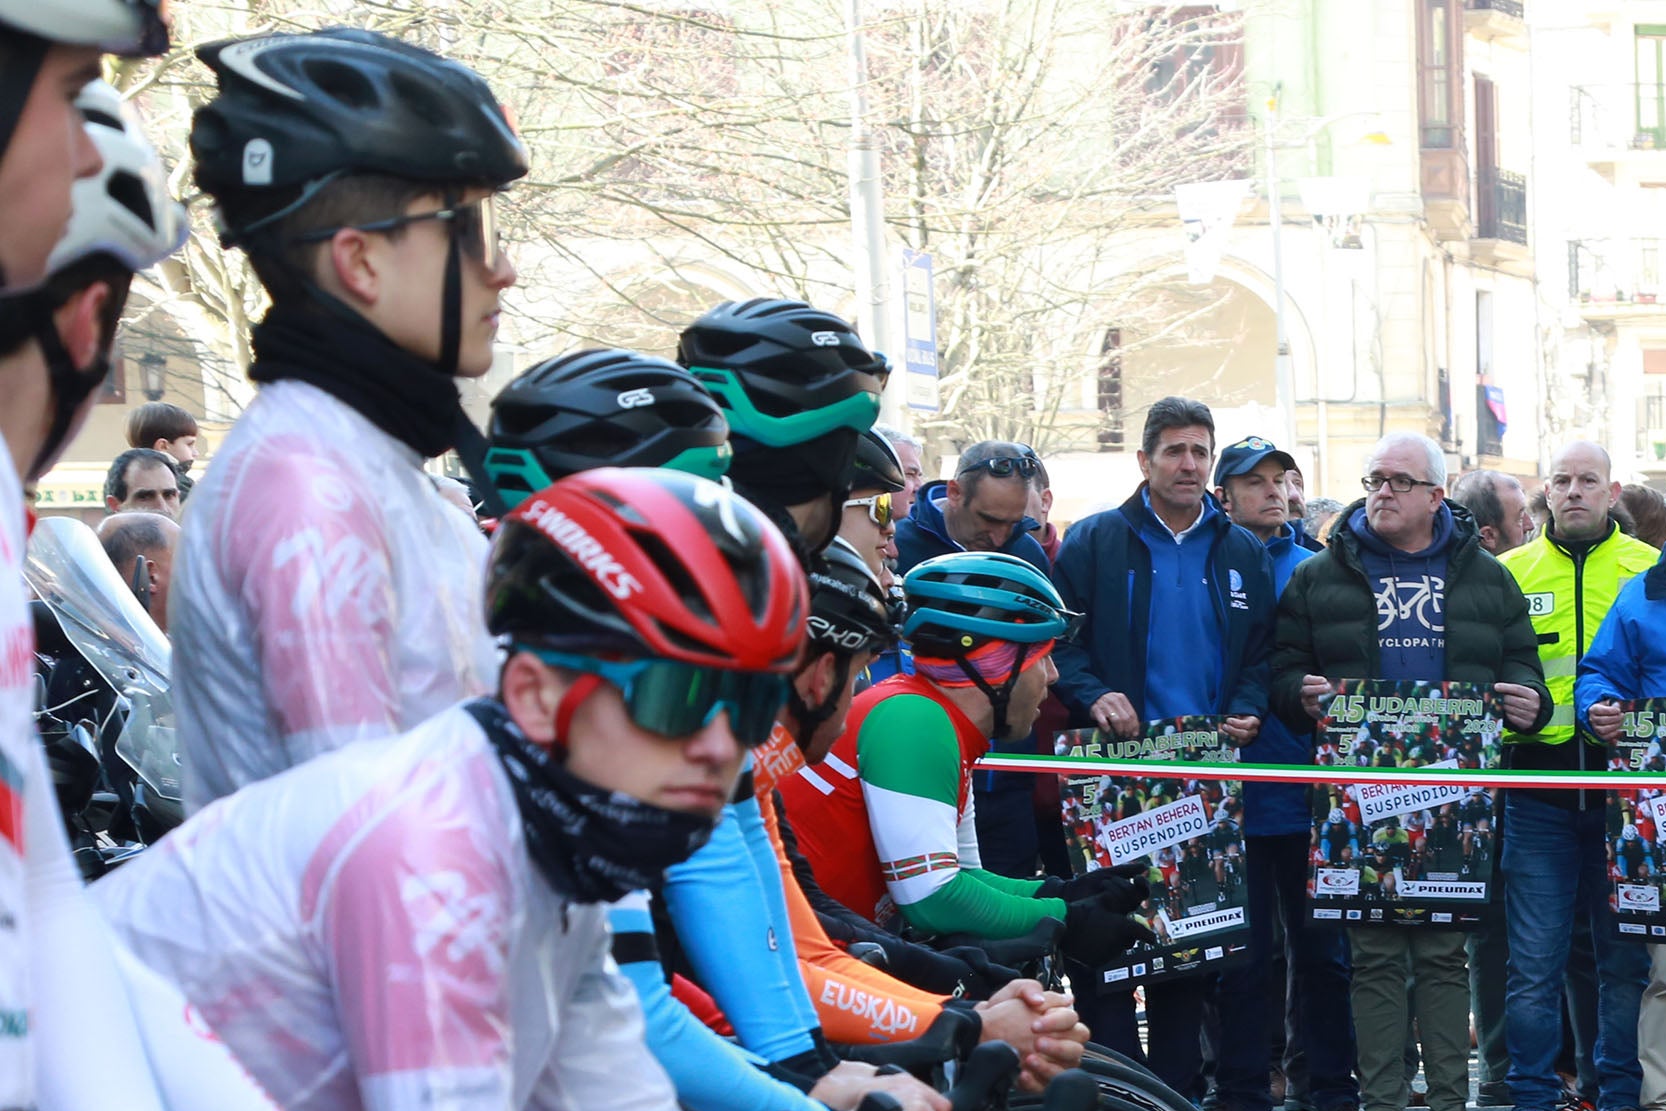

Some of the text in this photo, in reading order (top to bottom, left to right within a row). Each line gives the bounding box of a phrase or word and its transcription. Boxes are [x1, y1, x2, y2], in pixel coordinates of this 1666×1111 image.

[520, 500, 644, 600] S-WORKS
[1328, 695, 1483, 723] 45 UDABERRI
[1463, 719, 1497, 733] 2023
[1621, 711, 1655, 738] 45
[1107, 731, 1218, 759] UDABERRI
[1339, 734, 1352, 753] 5
[1629, 749, 1644, 768] 5
[1083, 785, 1095, 804] 5
[1365, 785, 1459, 815] SUSPENDIDO
[1108, 802, 1200, 842] BERTAN BEHERA
[1113, 818, 1203, 858] SUSPENDIDO
[1418, 885, 1483, 894] PNEUMAX
[1185, 911, 1242, 930] PNEUMAX
